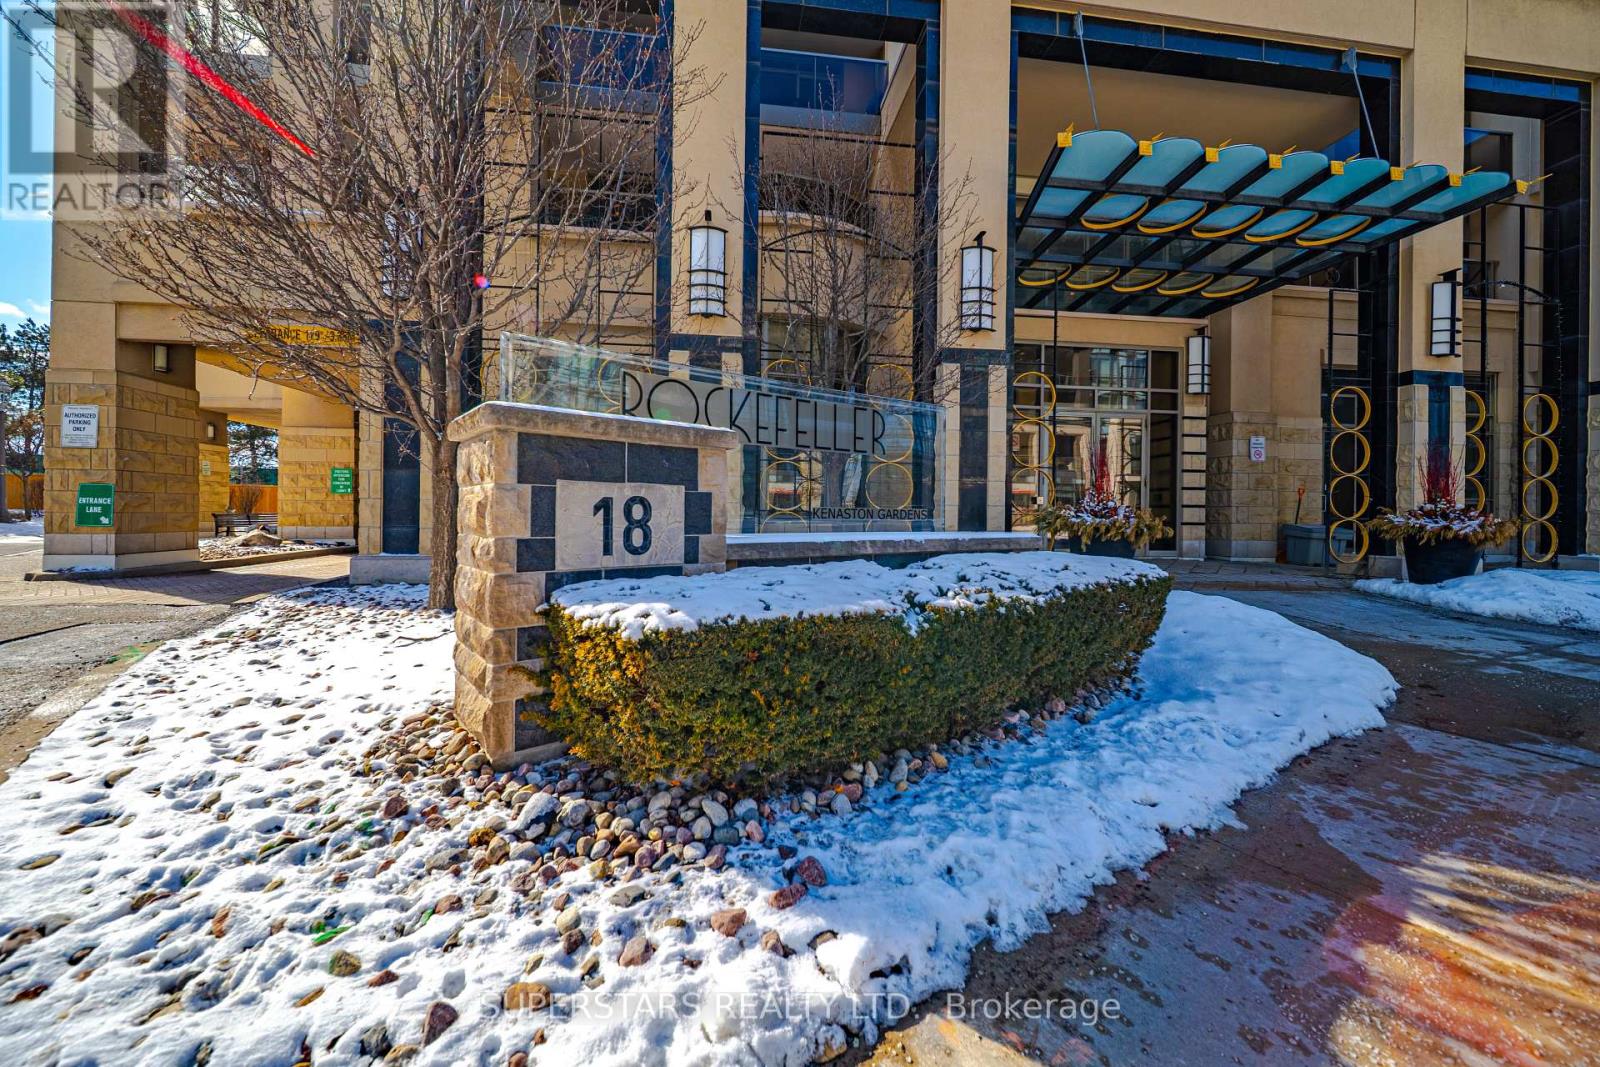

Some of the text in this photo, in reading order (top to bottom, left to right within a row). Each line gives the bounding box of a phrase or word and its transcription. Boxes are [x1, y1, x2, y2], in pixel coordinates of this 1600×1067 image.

[622, 370, 886, 455] ROCKEFELLER
[78, 496, 112, 504] ENTRANCE
[812, 507, 929, 520] KENASTON GARDENS
[592, 495, 653, 557] 18
